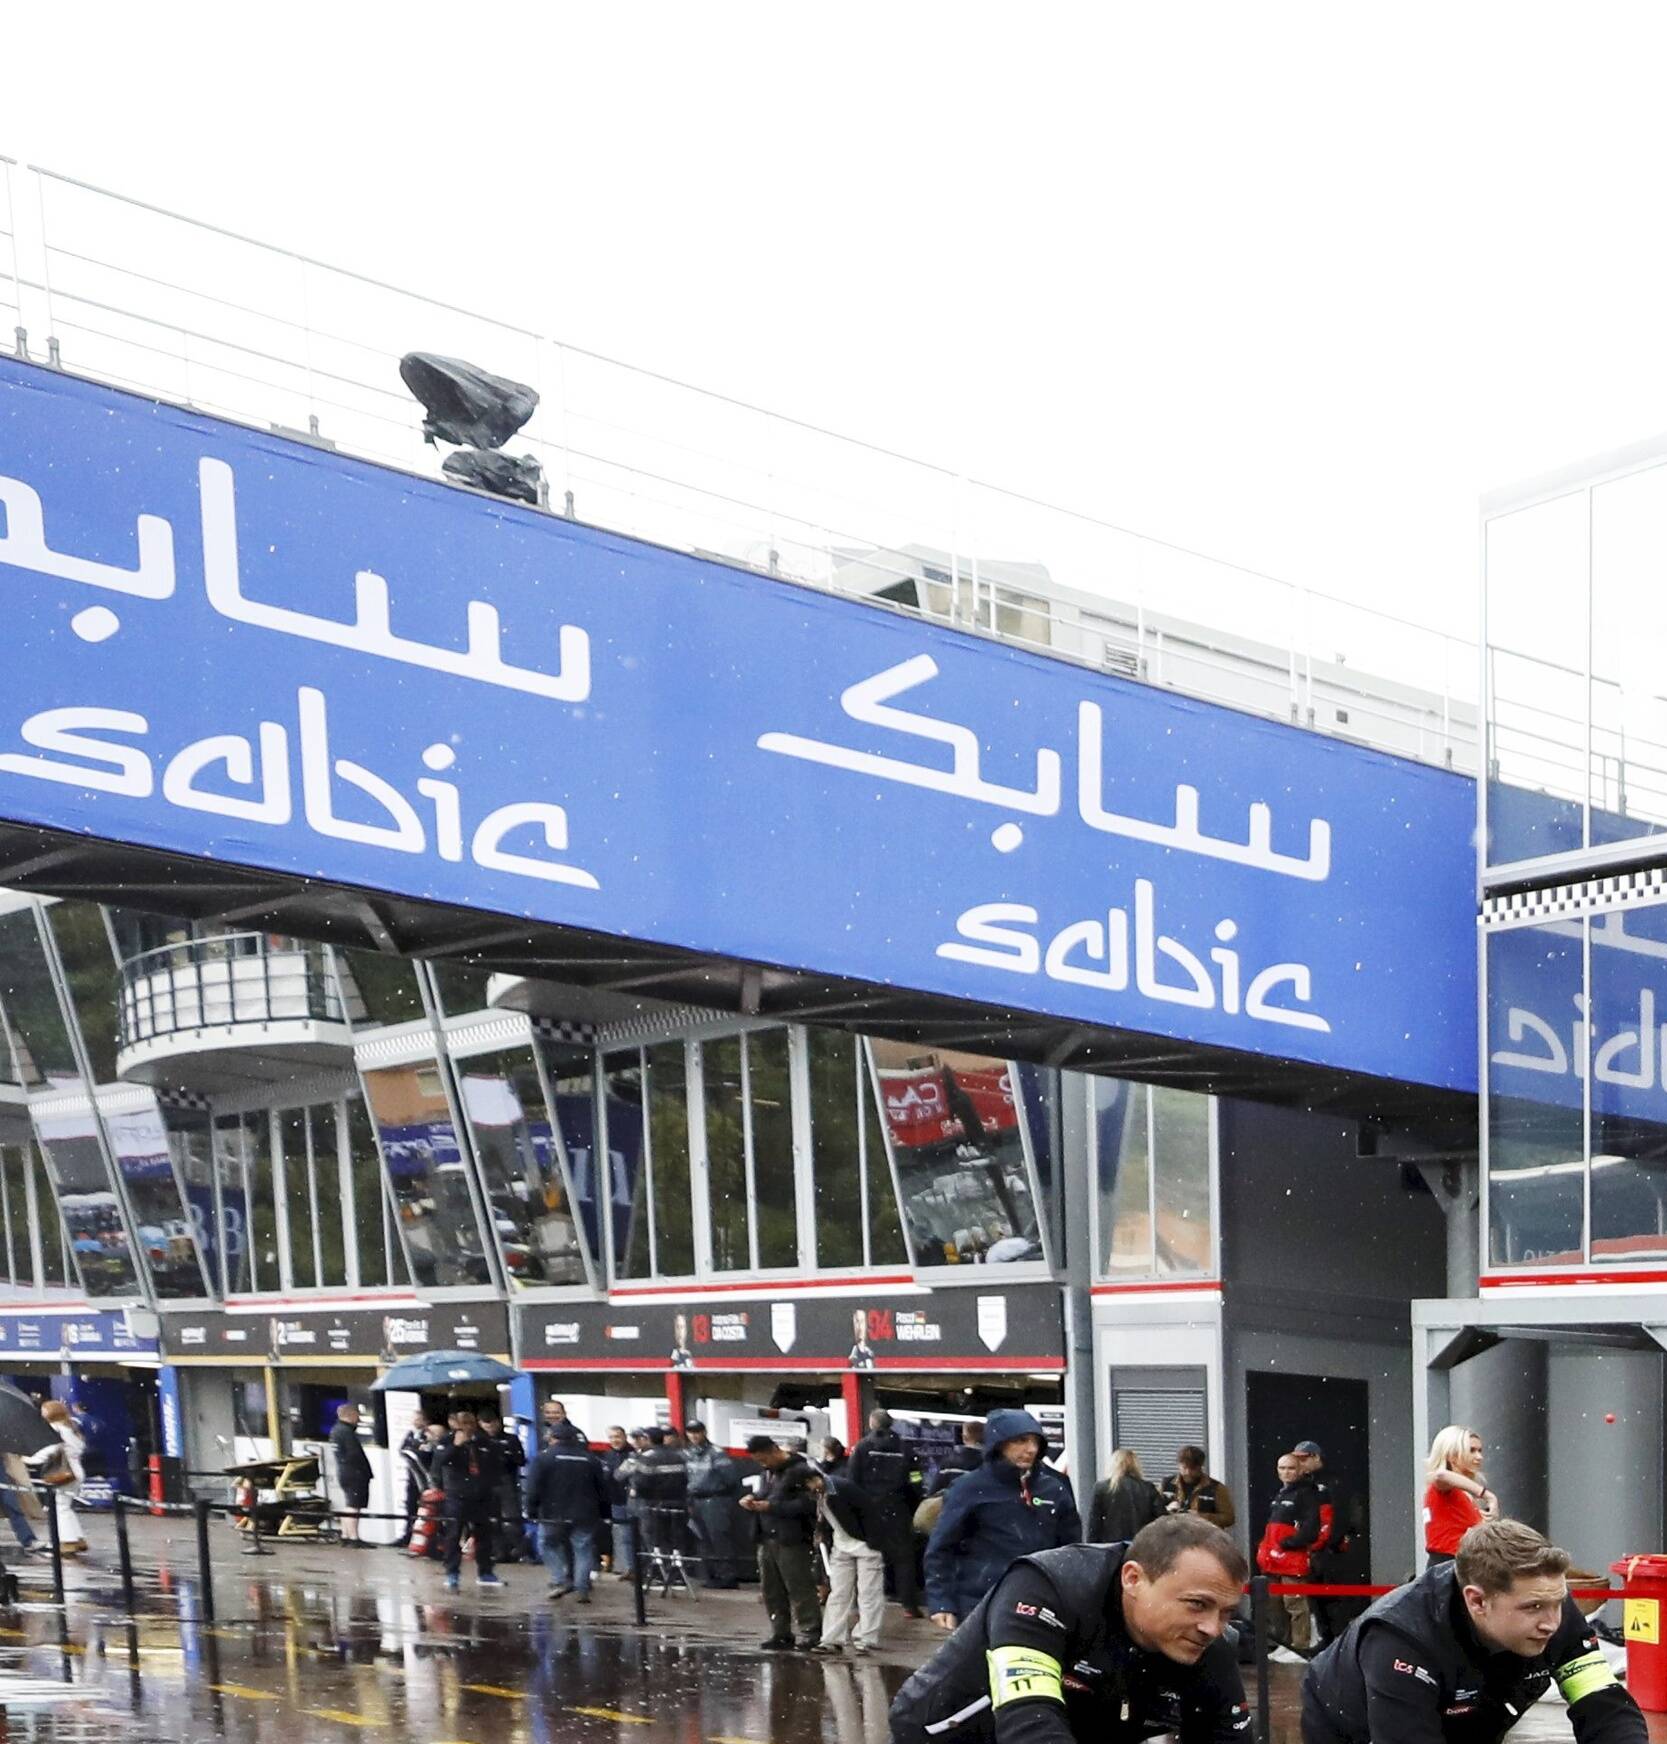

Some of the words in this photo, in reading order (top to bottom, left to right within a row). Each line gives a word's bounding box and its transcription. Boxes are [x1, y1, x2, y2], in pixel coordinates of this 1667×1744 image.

[0, 457, 591, 704] ساب
[0, 687, 600, 891] sabic
[757, 653, 1333, 882] سابك
[937, 880, 1333, 1033] sabic
